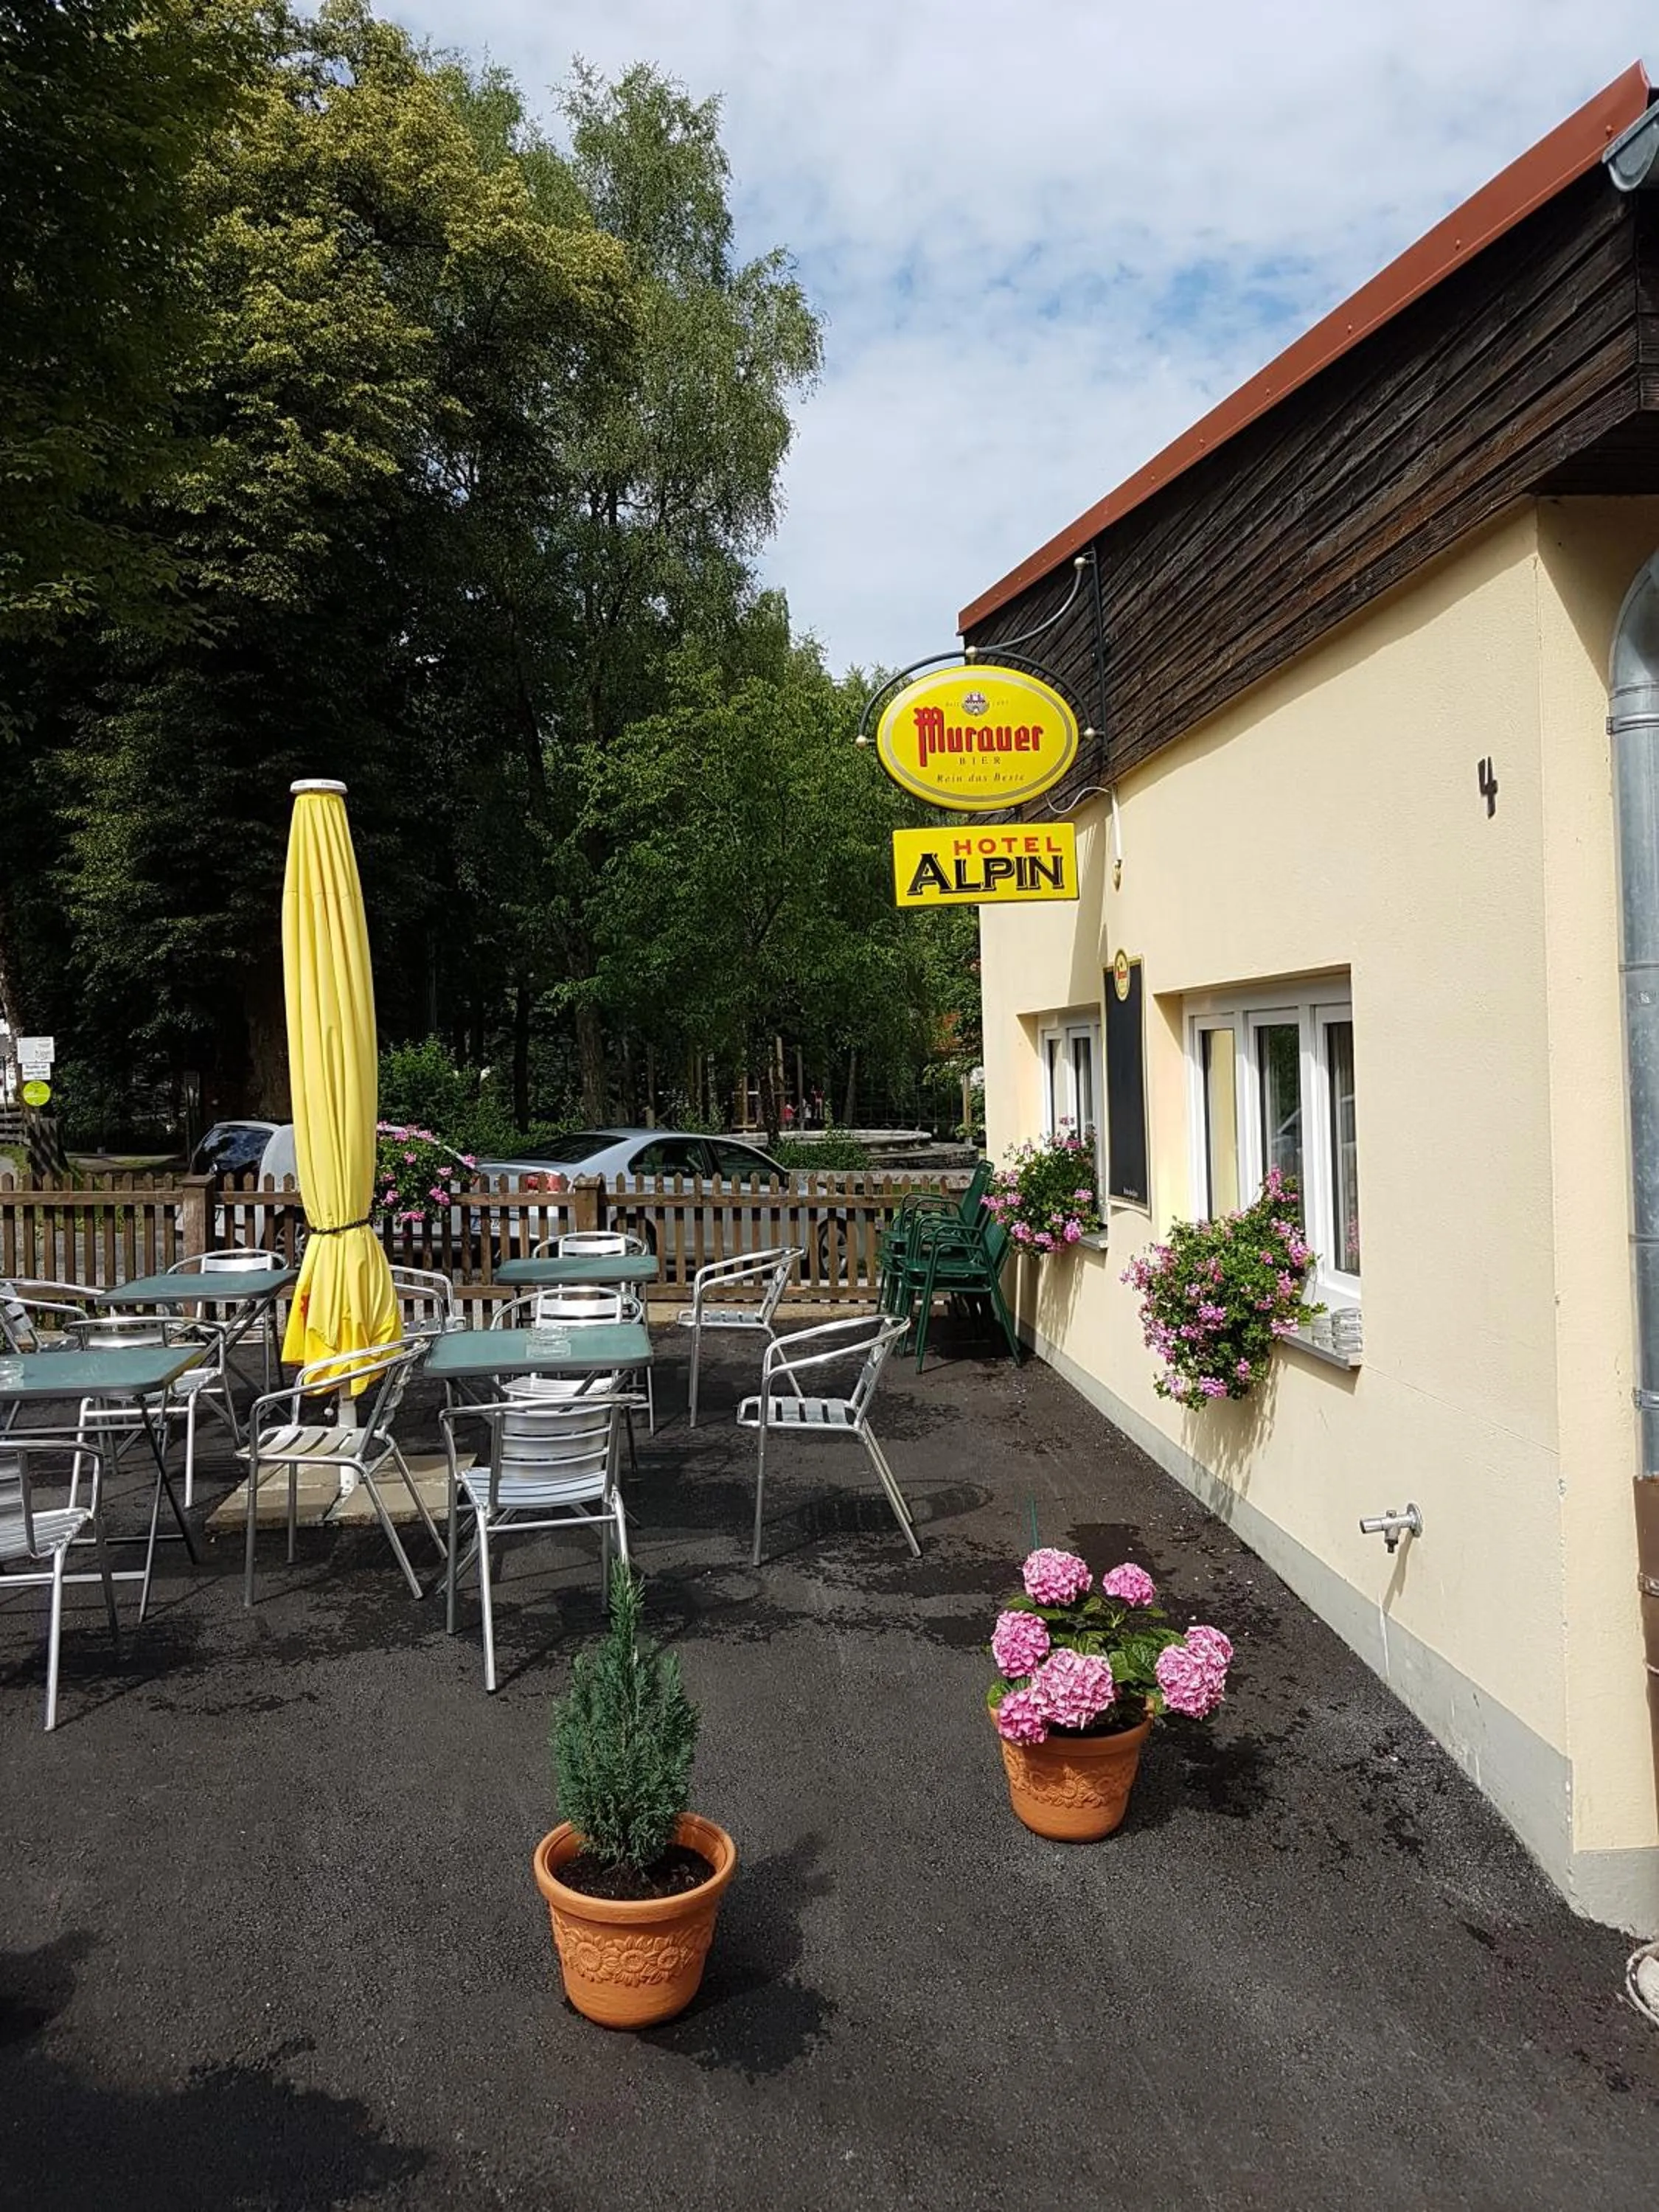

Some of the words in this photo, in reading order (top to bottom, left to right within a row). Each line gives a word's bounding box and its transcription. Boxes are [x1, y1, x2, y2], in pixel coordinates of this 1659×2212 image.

[914, 706, 1044, 767] Murauer
[959, 757, 1001, 765] BIER
[953, 836, 1062, 855] HOTEL
[906, 852, 1065, 895] ALPIN
